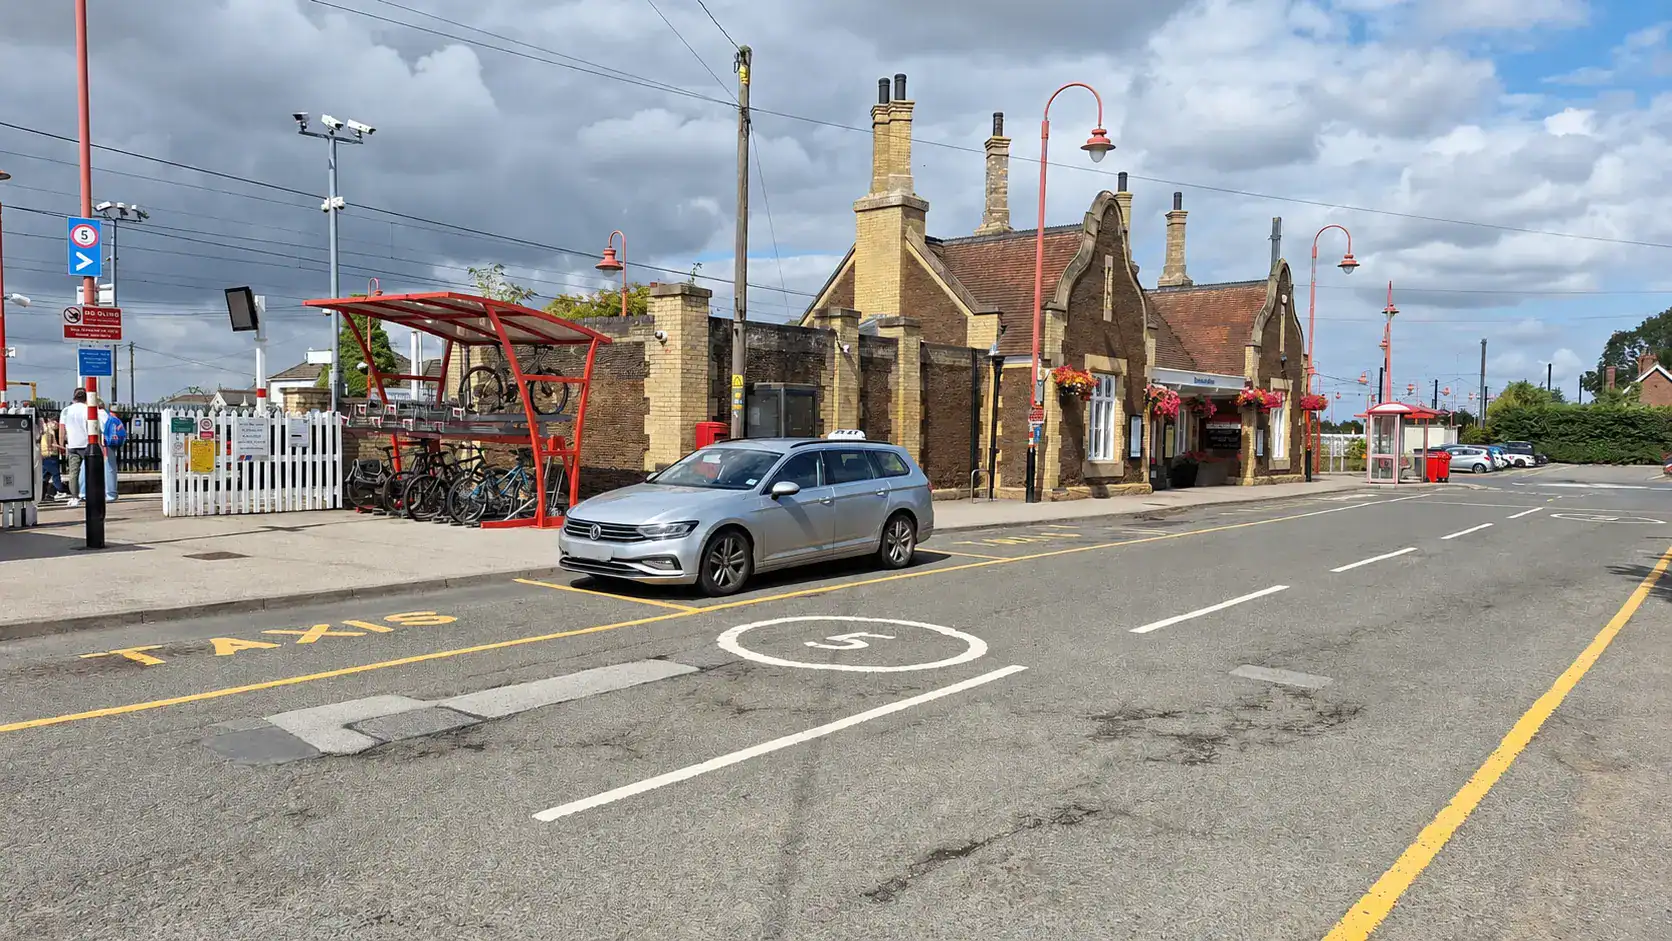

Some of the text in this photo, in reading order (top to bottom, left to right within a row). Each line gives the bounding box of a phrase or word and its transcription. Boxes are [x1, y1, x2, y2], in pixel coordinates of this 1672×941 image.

[81, 230, 88, 240] 5
[79, 611, 459, 666] TAXIS
[804, 632, 896, 650] 5
